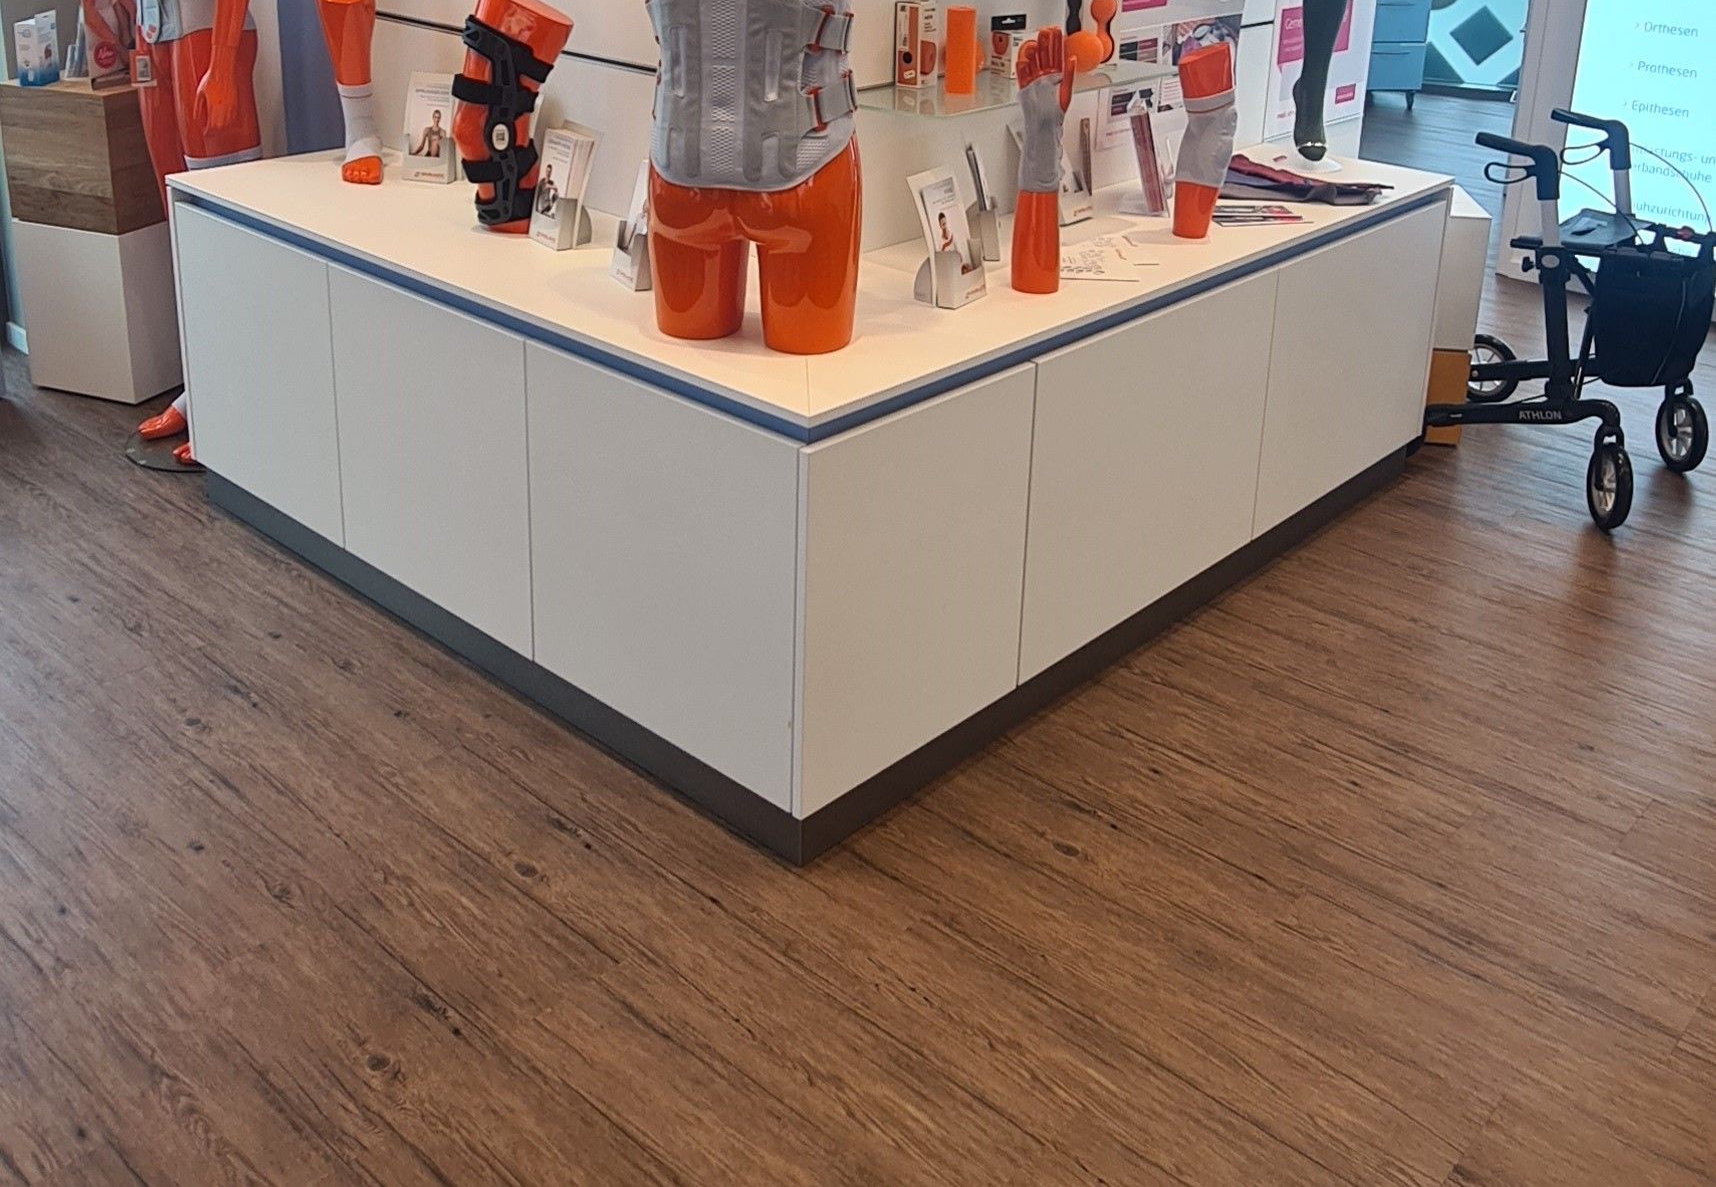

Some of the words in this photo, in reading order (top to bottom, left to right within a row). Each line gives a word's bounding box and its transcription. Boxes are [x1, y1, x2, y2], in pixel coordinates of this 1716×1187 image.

[1644, 21, 1699, 37] Orthesen
[1637, 60, 1698, 78] Prothesen
[1631, 100, 1690, 118] Epithesen
[1518, 409, 1562, 421] ATHLON
